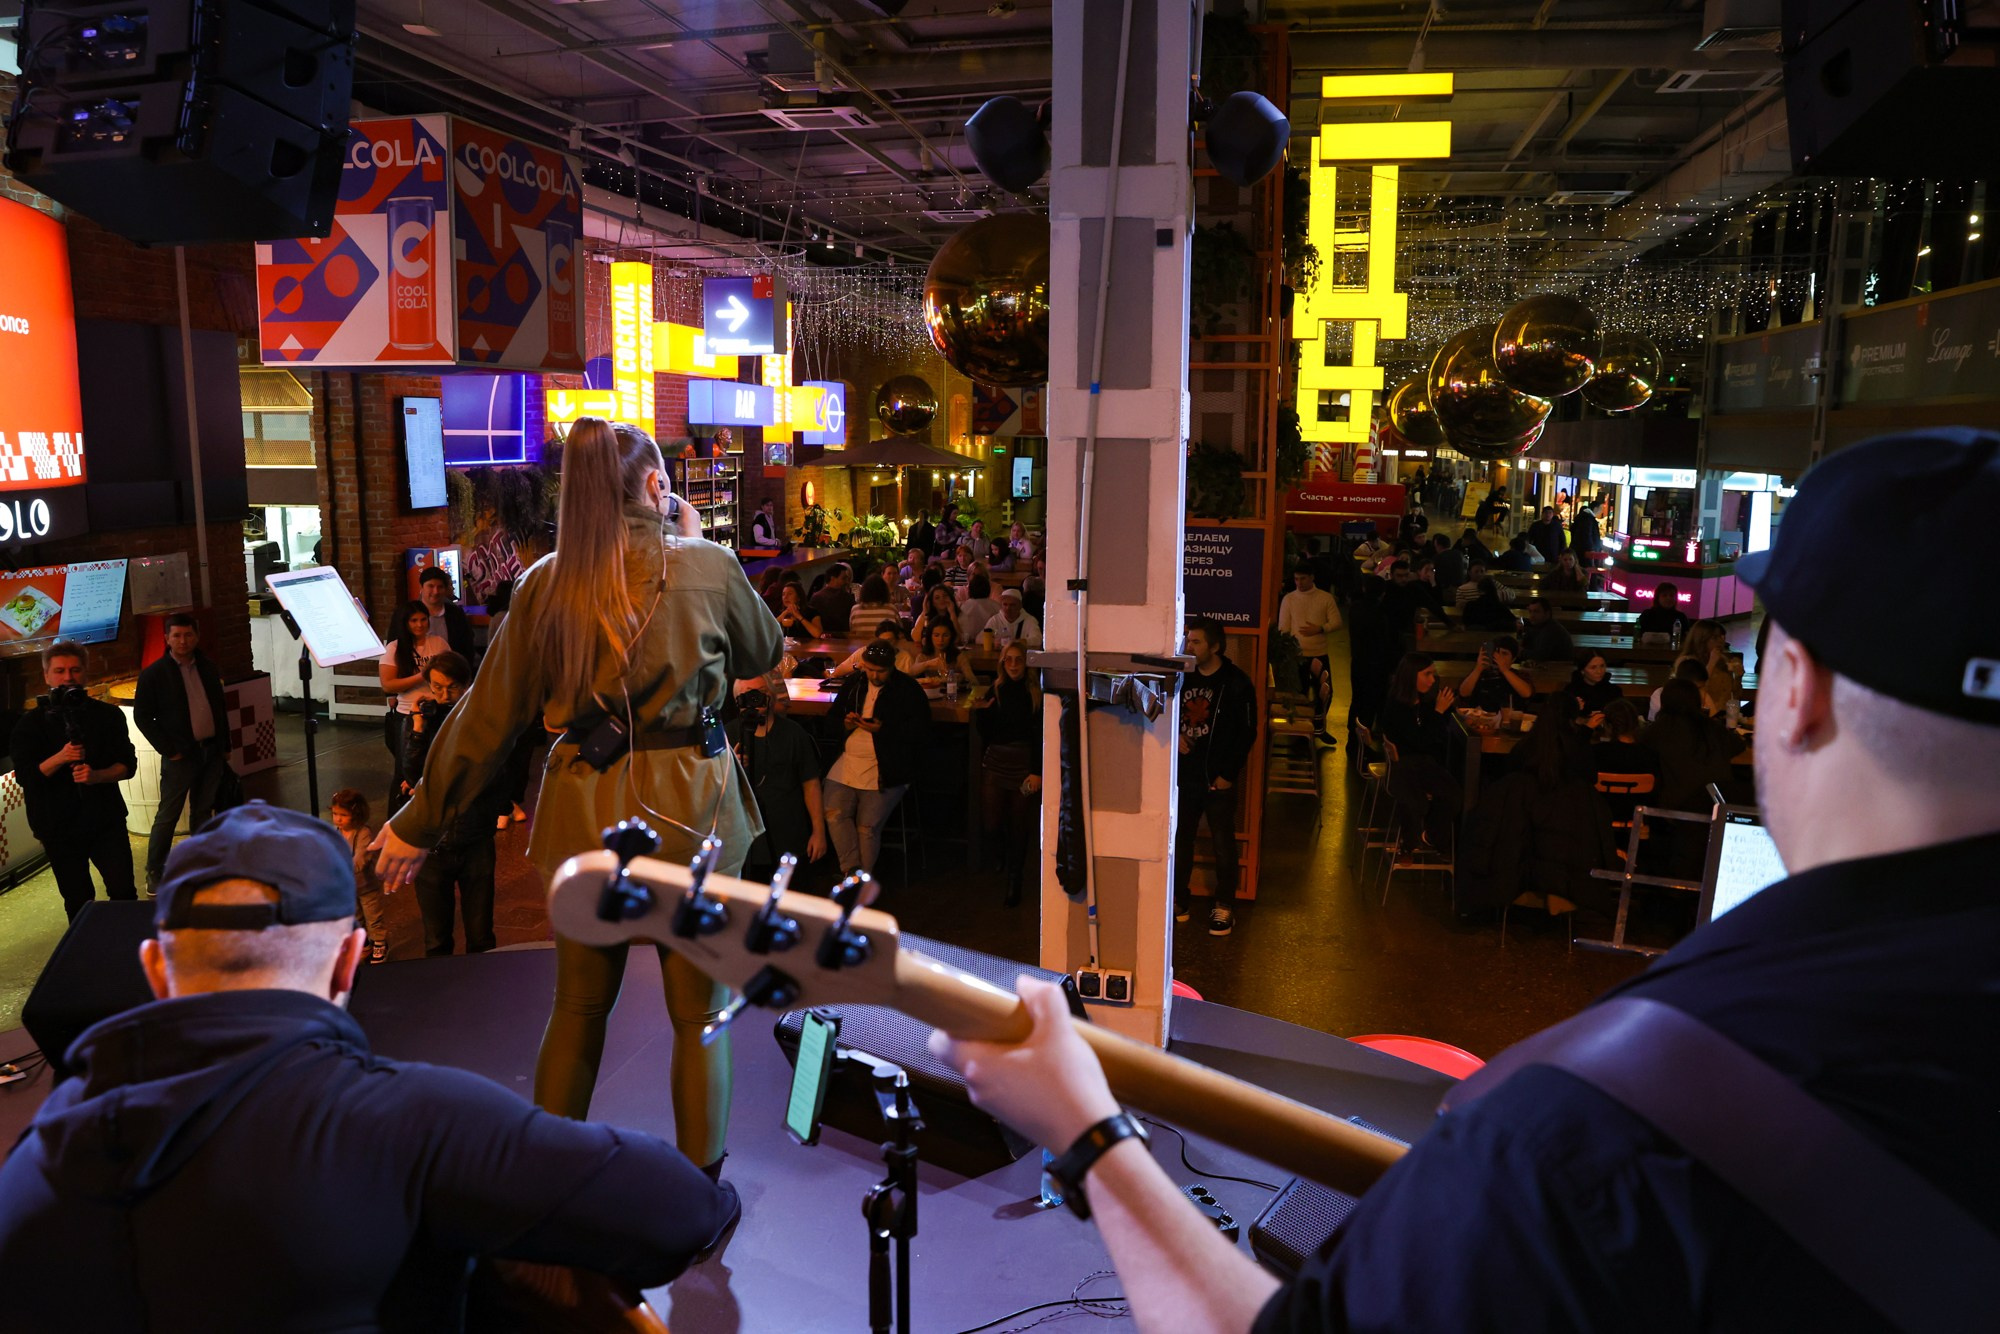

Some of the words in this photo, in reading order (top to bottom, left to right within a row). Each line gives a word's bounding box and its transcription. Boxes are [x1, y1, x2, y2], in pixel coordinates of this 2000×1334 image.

[465, 141, 575, 199] COOLCOLA
[397, 285, 428, 297] COOL
[397, 297, 429, 310] COLA
[614, 283, 636, 373] COCKTAIL
[1861, 342, 1907, 362] PREMIUM
[735, 389, 756, 419] BAR
[1299, 491, 1334, 502] Счастье
[1349, 495, 1387, 503] моменте
[1184, 545, 1233, 556] АЗНИЦУ
[1185, 556, 1214, 565] ЕРЕЗ
[1202, 611, 1251, 622] WINBAR
